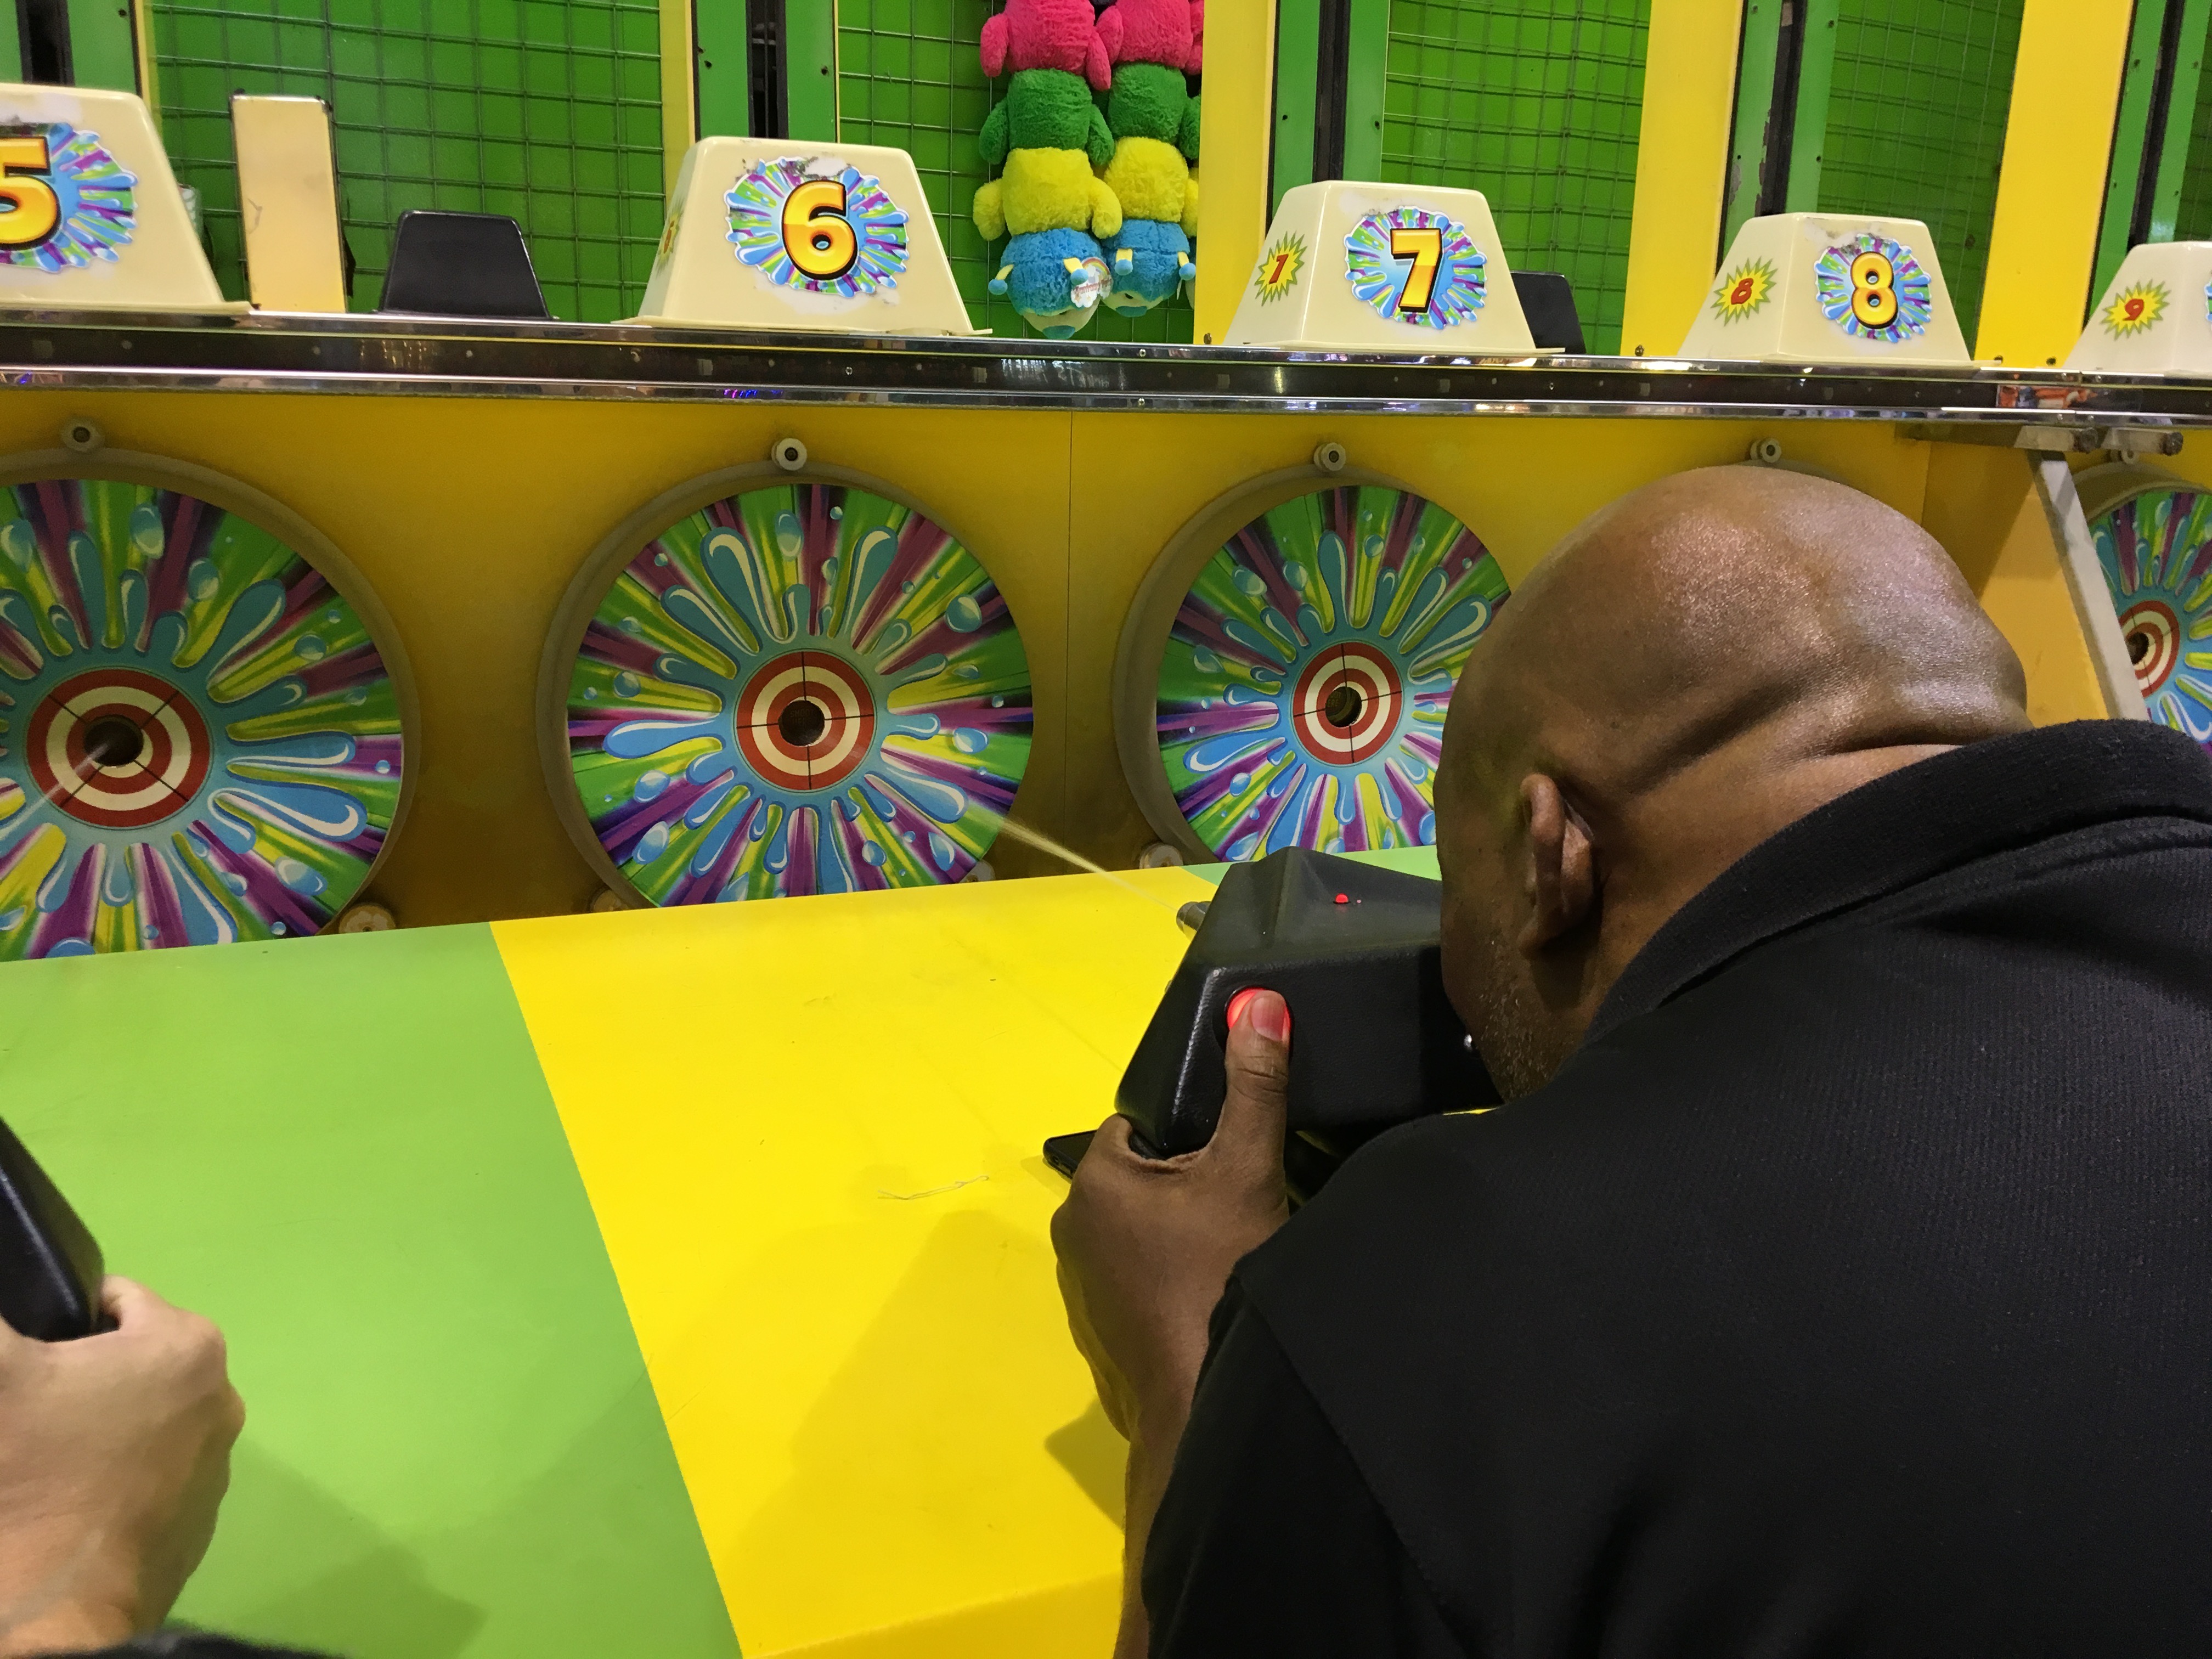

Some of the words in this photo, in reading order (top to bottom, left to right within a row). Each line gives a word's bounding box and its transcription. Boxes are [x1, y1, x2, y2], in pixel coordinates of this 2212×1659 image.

[0, 136, 61, 250] 5
[781, 179, 858, 280] 6
[1390, 228, 1442, 313] 7
[1731, 278, 1754, 305] 8
[1850, 251, 1898, 329] 8
[2123, 298, 2145, 321] 9
